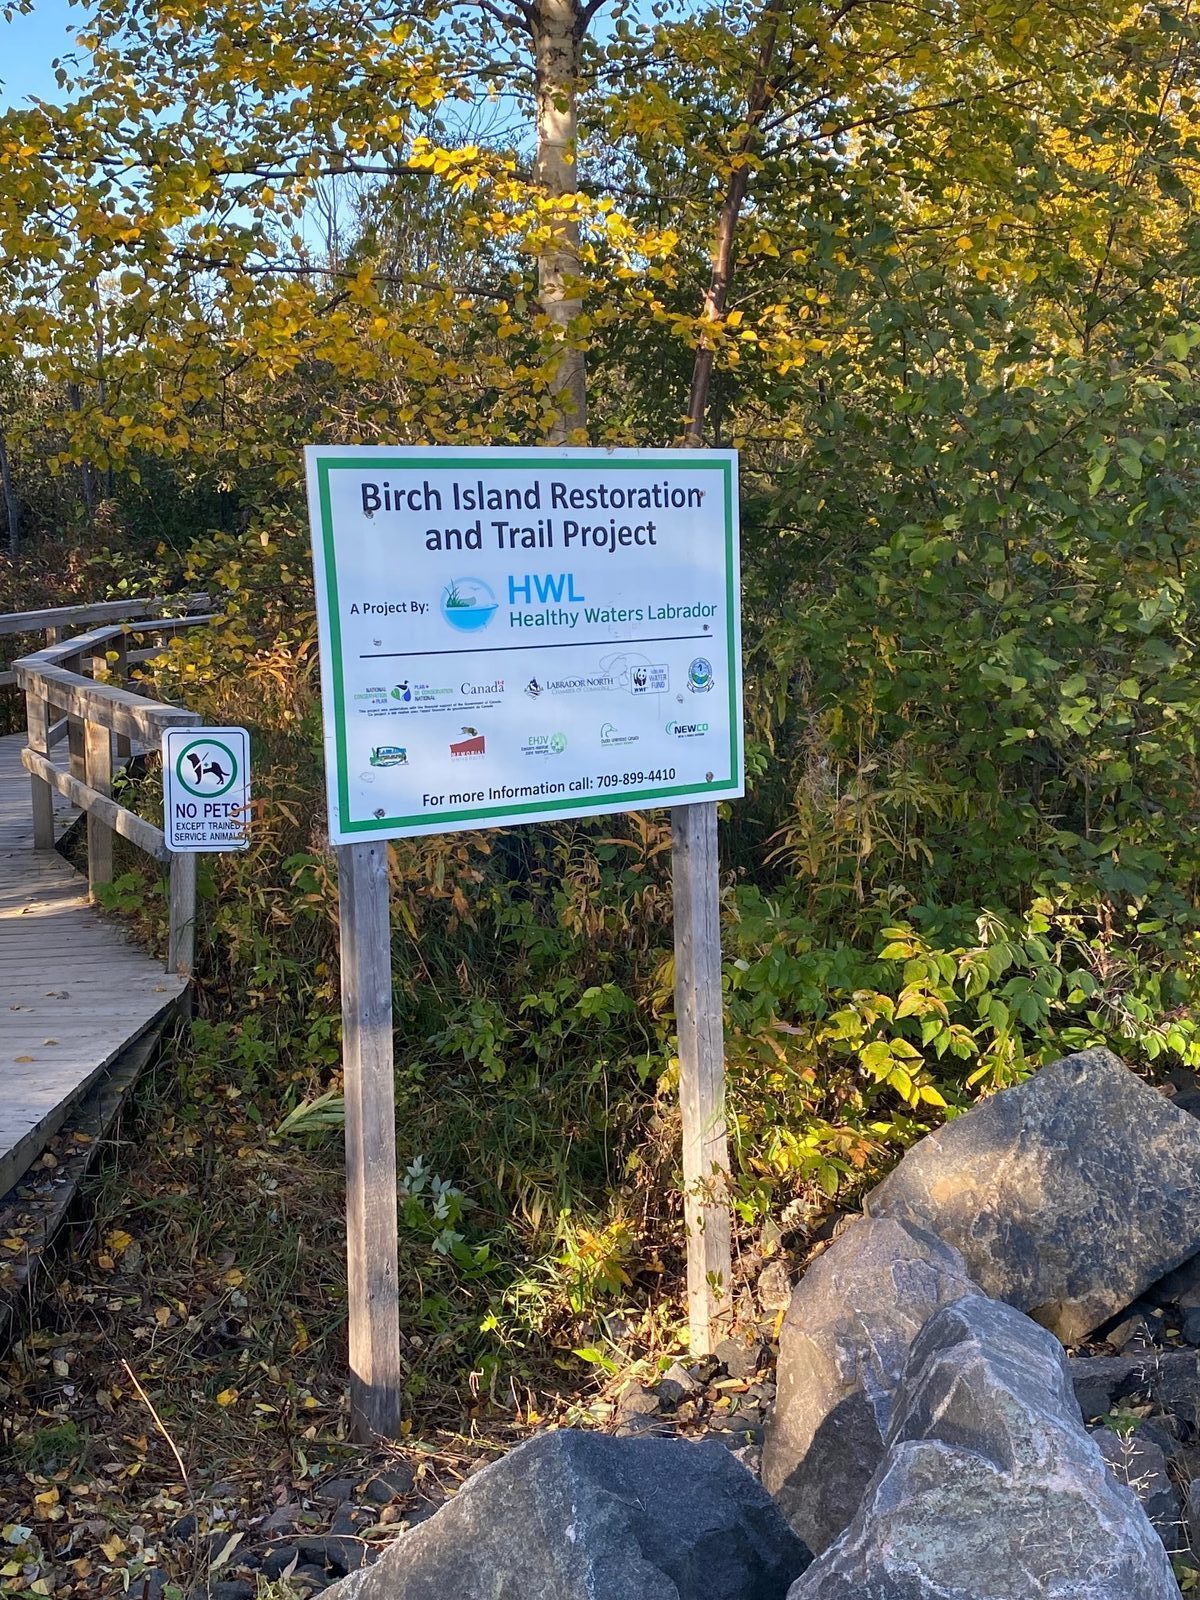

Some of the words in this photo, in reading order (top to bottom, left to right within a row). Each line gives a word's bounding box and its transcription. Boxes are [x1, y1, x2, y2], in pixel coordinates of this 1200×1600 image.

[361, 480, 442, 511] Birch
[452, 480, 541, 511] Island
[550, 480, 702, 509] Restoration
[425, 520, 483, 551] and
[491, 519, 553, 549] Trail
[563, 519, 657, 553] Project
[507, 573, 585, 605] HWL
[350, 603, 360, 615] A
[363, 602, 407, 616] Project
[410, 600, 429, 614] By:
[509, 609, 579, 628] Healthy
[584, 607, 643, 623] Waters
[648, 602, 717, 620] Labrador
[460, 680, 504, 695] Canada
[546, 680, 586, 690] LABRADOR
[587, 677, 614, 686] NORTH
[674, 723, 709, 734] NEWCO
[528, 735, 549, 746] EHJV
[422, 793, 444, 806] For
[449, 790, 485, 804] more
[488, 781, 565, 800] Information
[568, 777, 593, 791] call:
[597, 767, 676, 788] 709-899-4410
[176, 803, 197, 818] NO
[204, 803, 240, 818] PETS
[176, 822, 205, 831] EXCEPT
[208, 822, 240, 830] TRAINED
[174, 832, 207, 841] SERVICE
